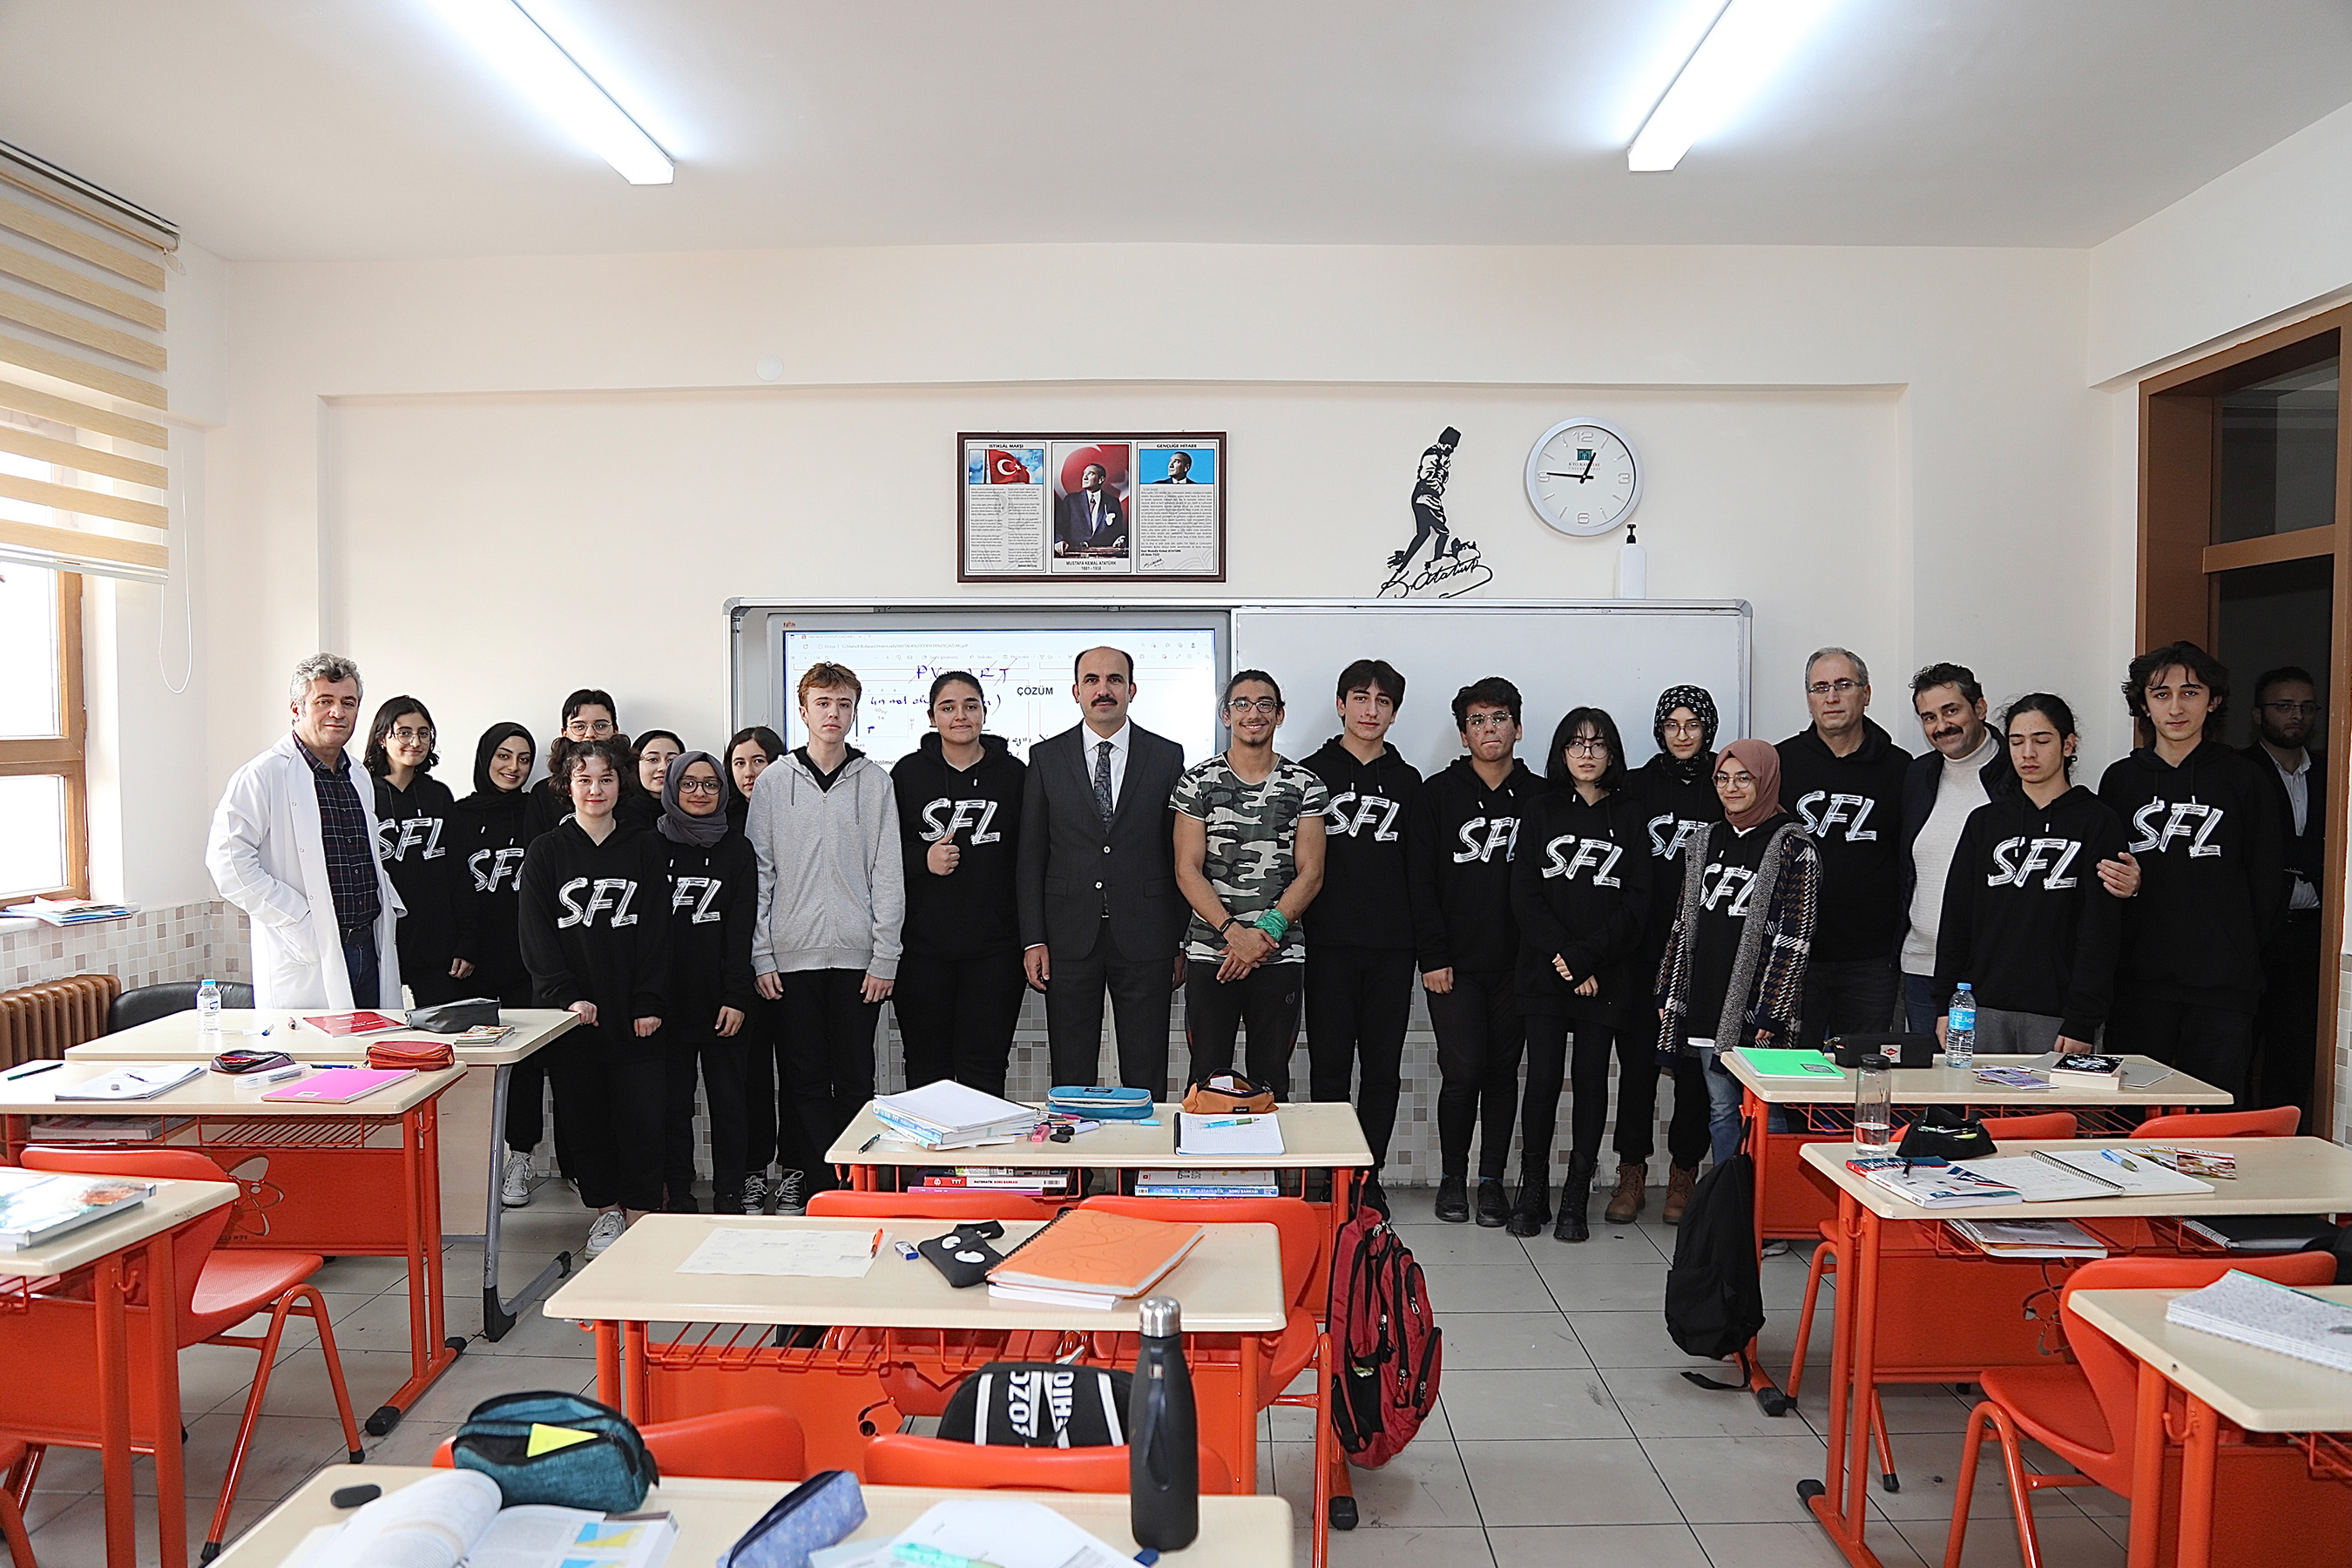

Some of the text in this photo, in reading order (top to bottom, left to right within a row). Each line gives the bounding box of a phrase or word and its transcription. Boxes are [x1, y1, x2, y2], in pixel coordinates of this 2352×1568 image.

[1572, 430, 1593, 443] 12
[1618, 472, 1631, 484] 3
[1578, 512, 1590, 524] 6
[1017, 685, 1053, 697] ÇÖZÜM
[378, 818, 446, 862] SFL
[921, 797, 1001, 846] SFL
[1326, 791, 1401, 842] SFL
[1647, 812, 1708, 861] SF
[1796, 790, 1876, 842] SFL
[2128, 798, 2224, 858] SFL
[1542, 834, 1623, 889] SFL
[1987, 837, 2082, 890] SFL
[558, 877, 639, 929] SFL
[667, 875, 722, 926] FL
